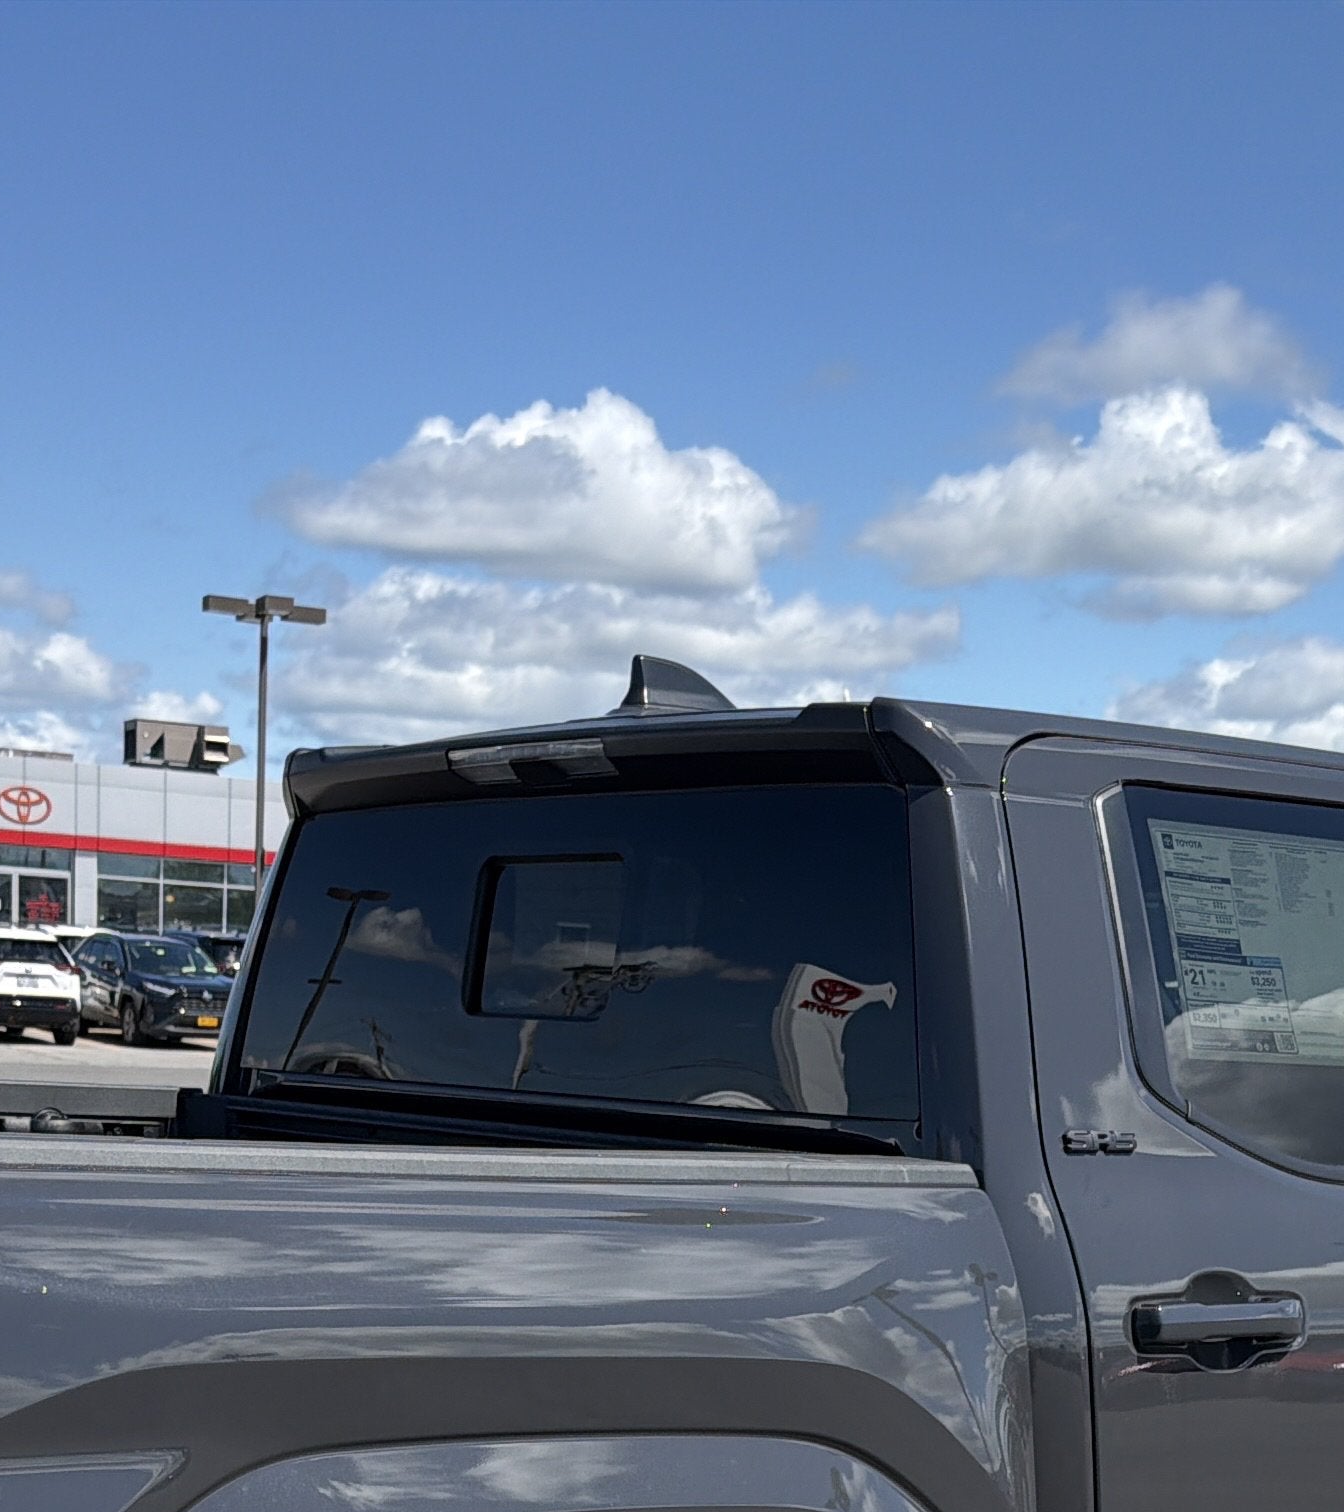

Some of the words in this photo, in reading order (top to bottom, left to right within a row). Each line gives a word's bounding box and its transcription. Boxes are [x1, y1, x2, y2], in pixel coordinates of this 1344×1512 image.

[1175, 838, 1203, 850] TOYOTA
[1189, 968, 1207, 986] 21
[1250, 976, 1277, 987] $3,250
[1062, 1129, 1138, 1155] SR5
